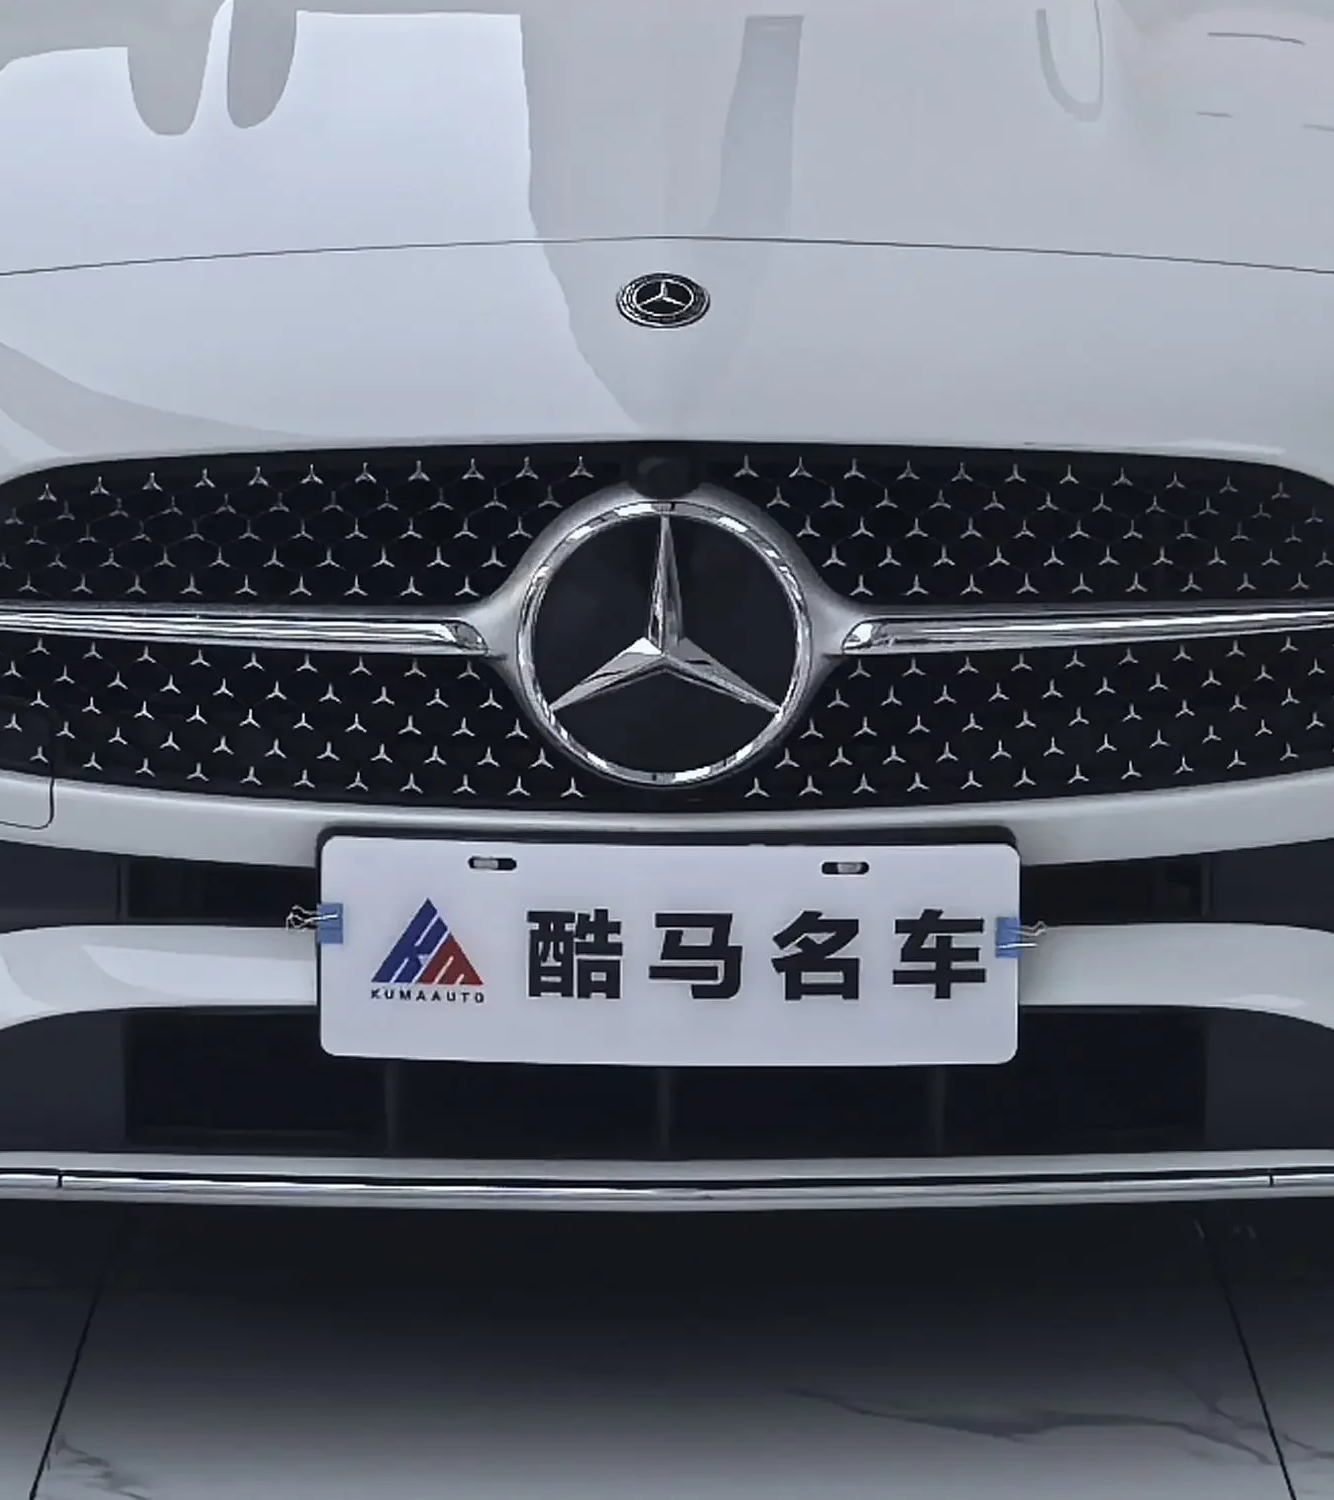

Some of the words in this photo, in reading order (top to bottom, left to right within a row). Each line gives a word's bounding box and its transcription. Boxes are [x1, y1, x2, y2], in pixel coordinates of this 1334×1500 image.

[526, 908, 987, 1000] 酷马名车
[370, 988, 485, 1004] KUMAAUTO
